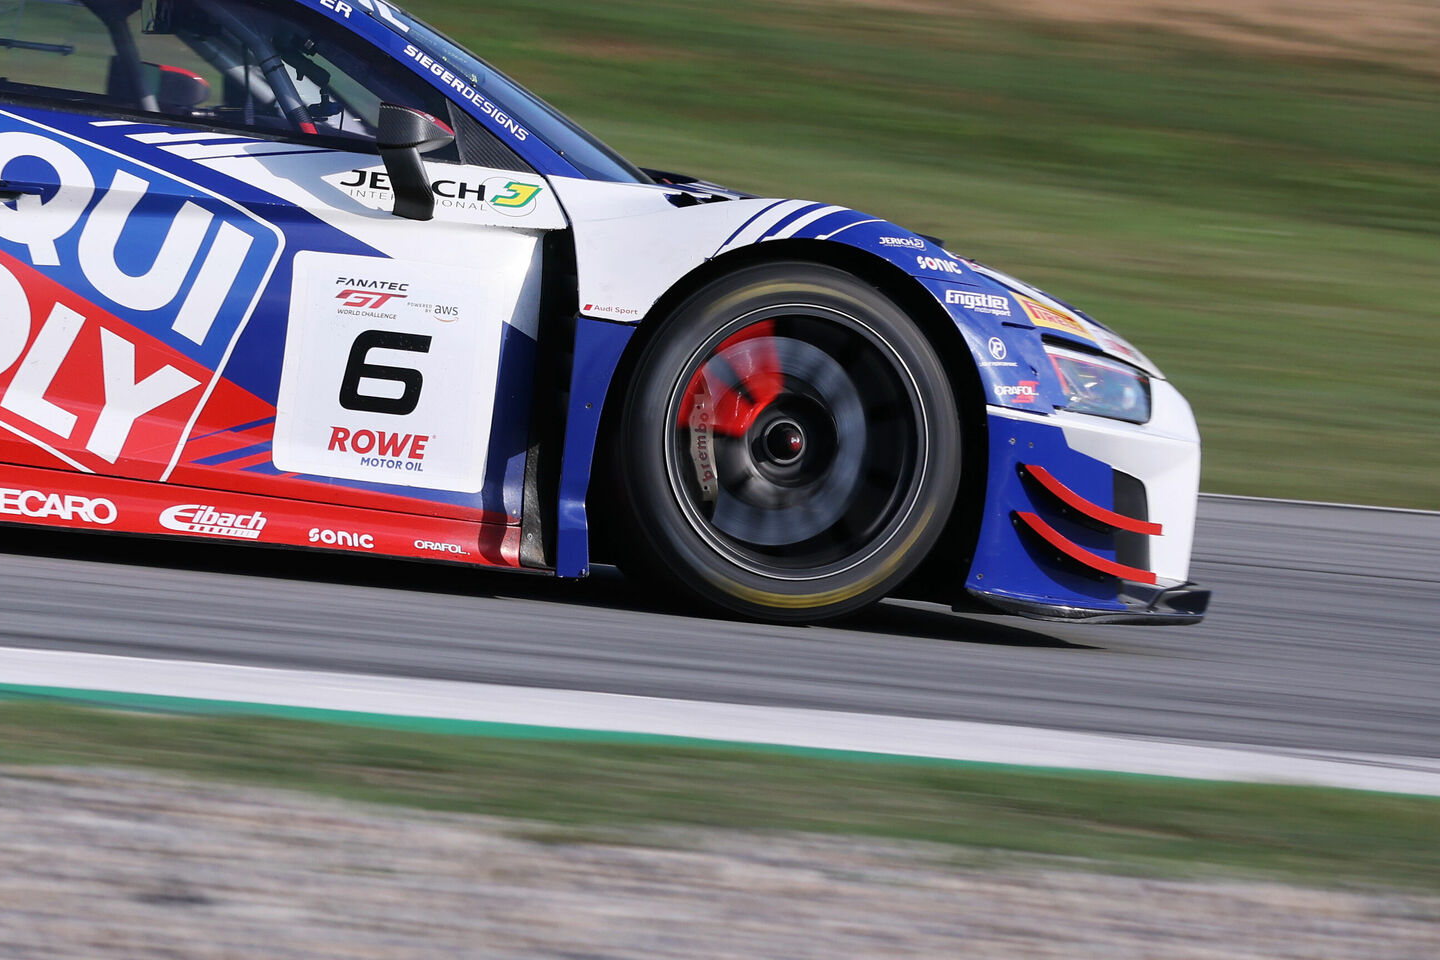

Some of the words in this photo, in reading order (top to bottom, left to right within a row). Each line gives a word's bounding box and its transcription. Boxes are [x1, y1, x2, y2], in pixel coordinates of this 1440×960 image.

[340, 169, 486, 203] JECH
[350, 189, 488, 211] INTEIONAL
[336, 277, 409, 292] FANATEC
[337, 308, 360, 317] WORLD
[361, 310, 397, 320] CHALLENGE
[434, 304, 459, 316] aws
[594, 304, 613, 313] Audi
[615, 306, 638, 316] Sport
[339, 328, 433, 416] 6
[328, 426, 430, 460] ROWE
[695, 413, 714, 482] brembo
[360, 456, 403, 470] MOTOR
[405, 460, 424, 472] OIL
[159, 504, 267, 534] Eibach
